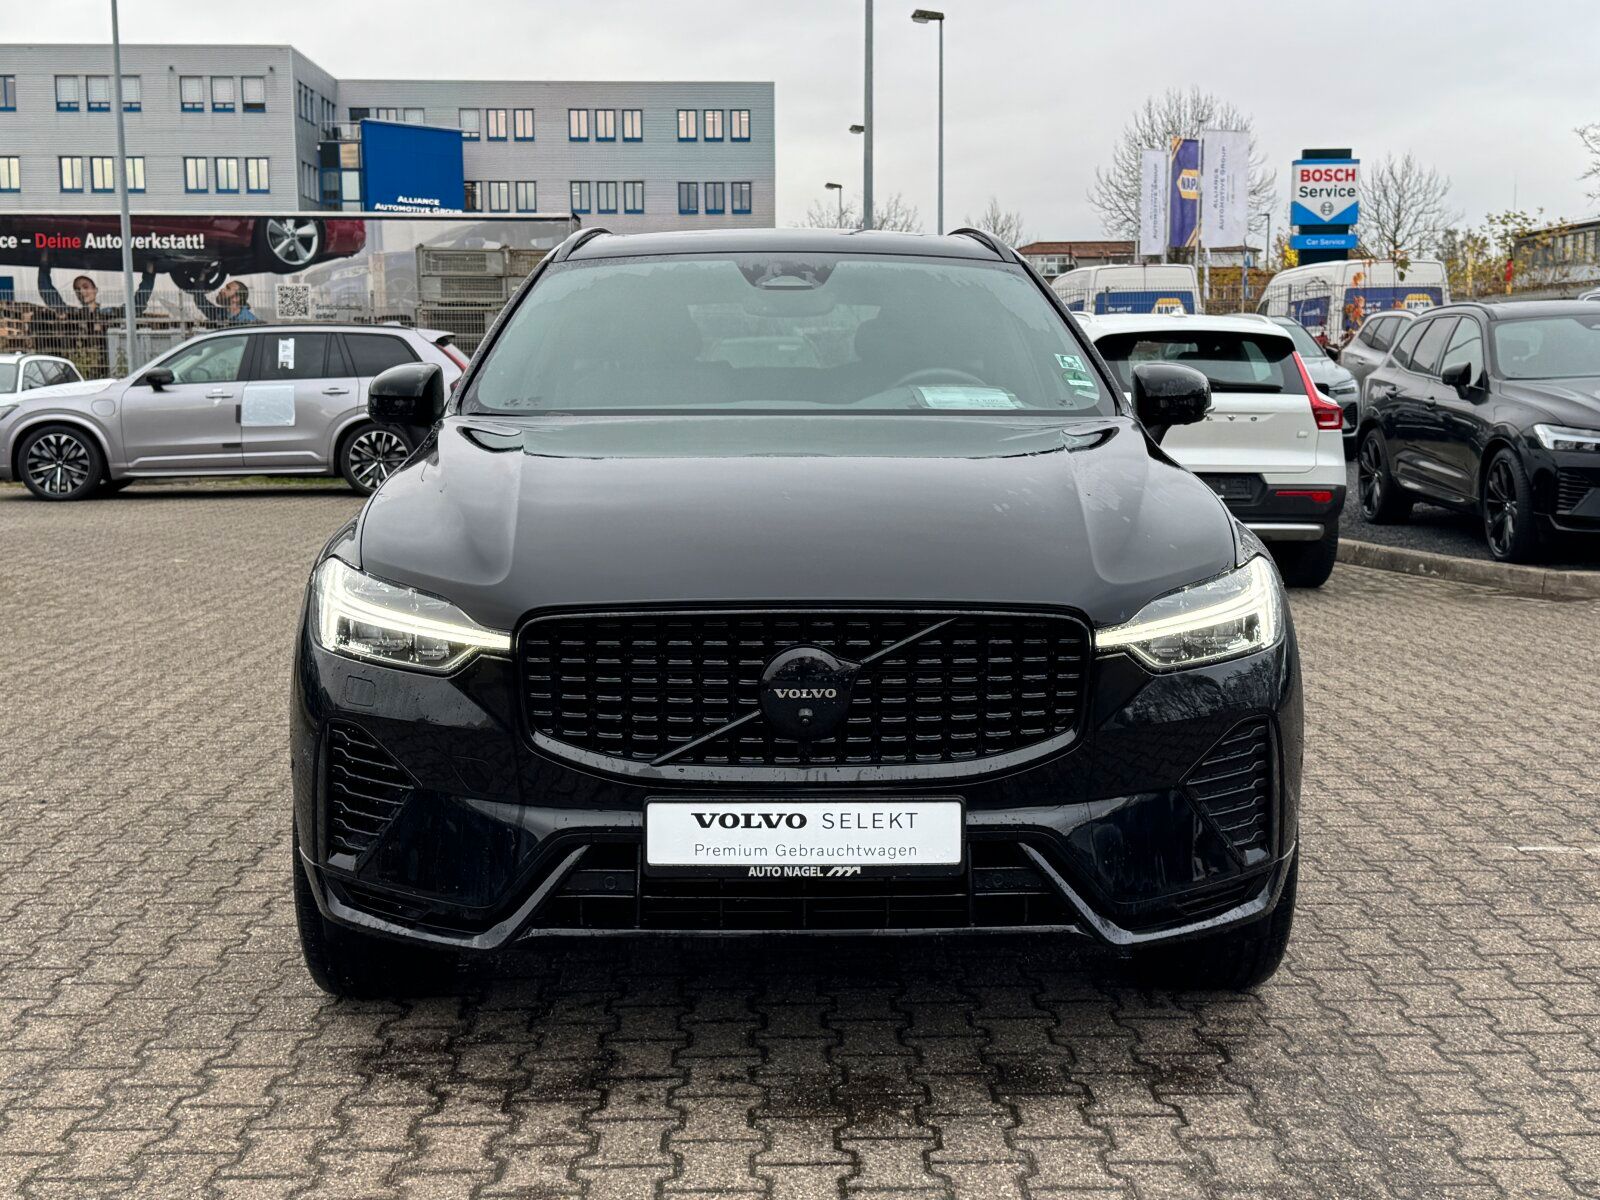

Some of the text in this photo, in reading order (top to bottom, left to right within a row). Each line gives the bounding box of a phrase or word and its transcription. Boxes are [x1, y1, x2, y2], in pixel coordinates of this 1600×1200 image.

[1301, 168, 1356, 182] BOSCH
[1299, 185, 1356, 198] Service
[397, 195, 441, 206] ALLIANCE
[374, 203, 431, 214] AUTOMOTIVE
[35, 232, 81, 249] Deine
[1306, 238, 1346, 246] Car Service
[773, 688, 837, 699] VOLVO
[691, 812, 919, 829] VOLVO SELEKT
[694, 843, 918, 860] Premium Gebrauchtwagen
[748, 866, 824, 877] AUTO NAGEL
